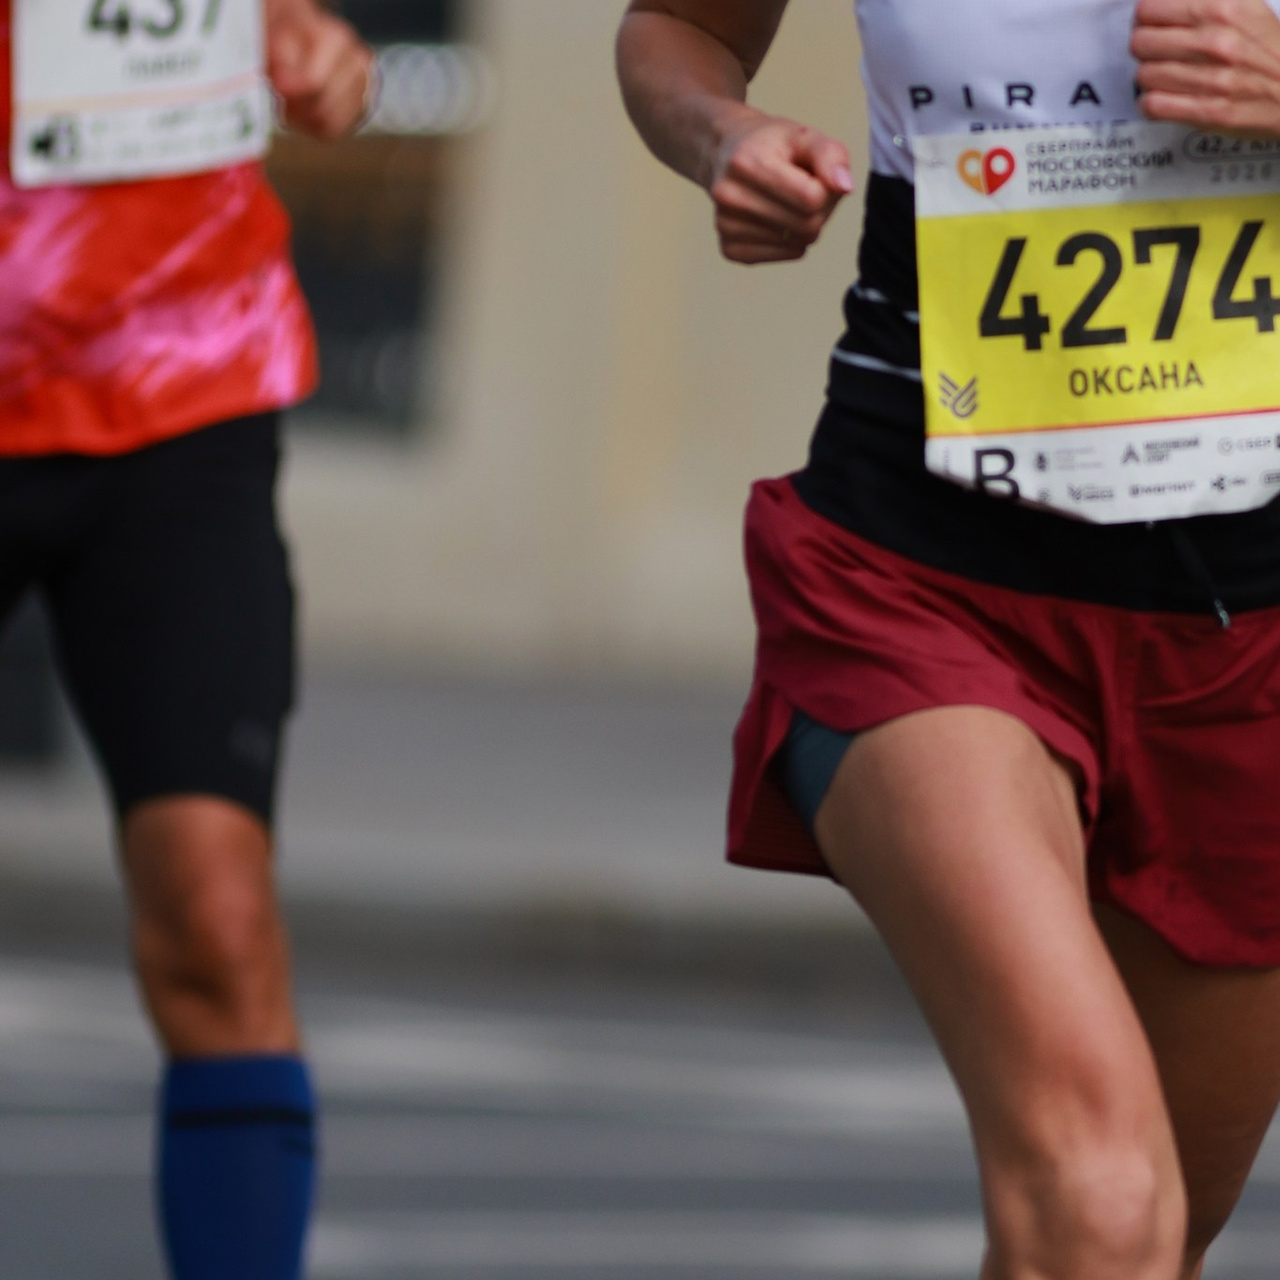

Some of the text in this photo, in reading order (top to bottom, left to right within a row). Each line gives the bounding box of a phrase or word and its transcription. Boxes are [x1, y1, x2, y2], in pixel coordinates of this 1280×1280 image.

[909, 81, 1142, 110] PIRA
[1027, 148, 1174, 174] МОСКОВСКИЙ
[1028, 173, 1136, 194] МАРАФОН
[1069, 359, 1204, 397] ОКСАНА
